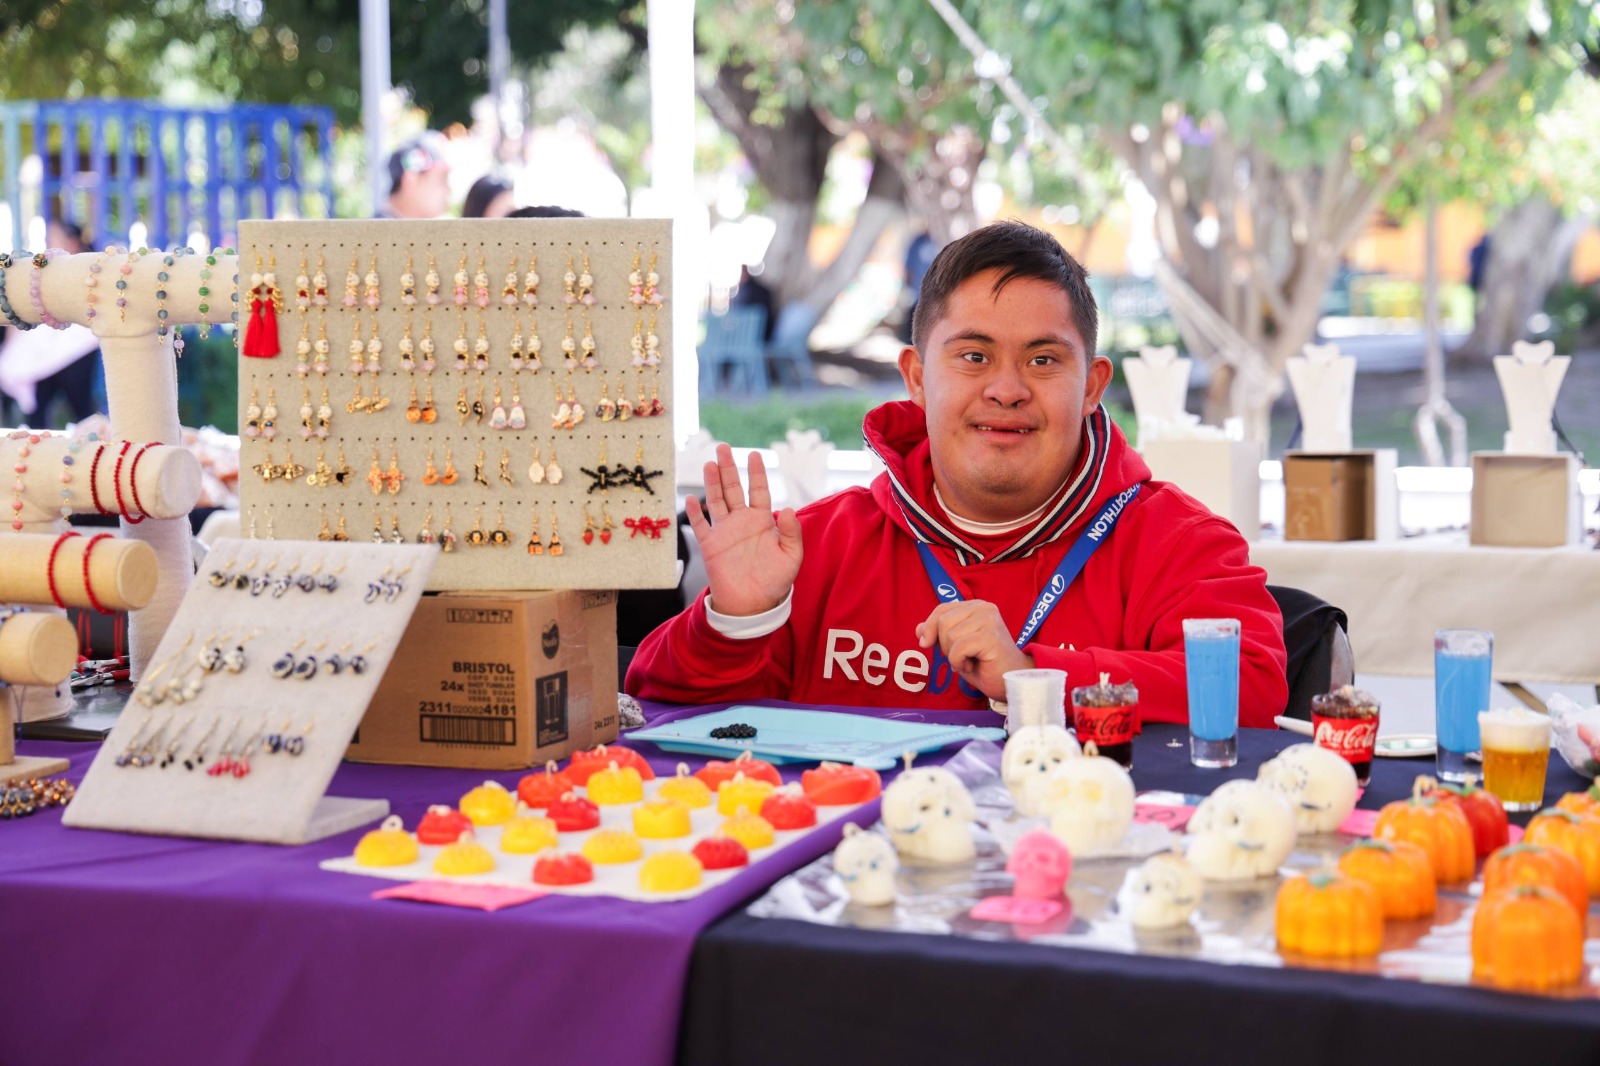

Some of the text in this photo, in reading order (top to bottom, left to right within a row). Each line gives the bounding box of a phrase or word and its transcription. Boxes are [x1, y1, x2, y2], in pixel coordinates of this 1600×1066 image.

[1015, 591, 1056, 646] DECATHL
[453, 662, 515, 675] BRISTOL
[822, 628, 986, 699] Reeb
[440, 680, 465, 692] 24x
